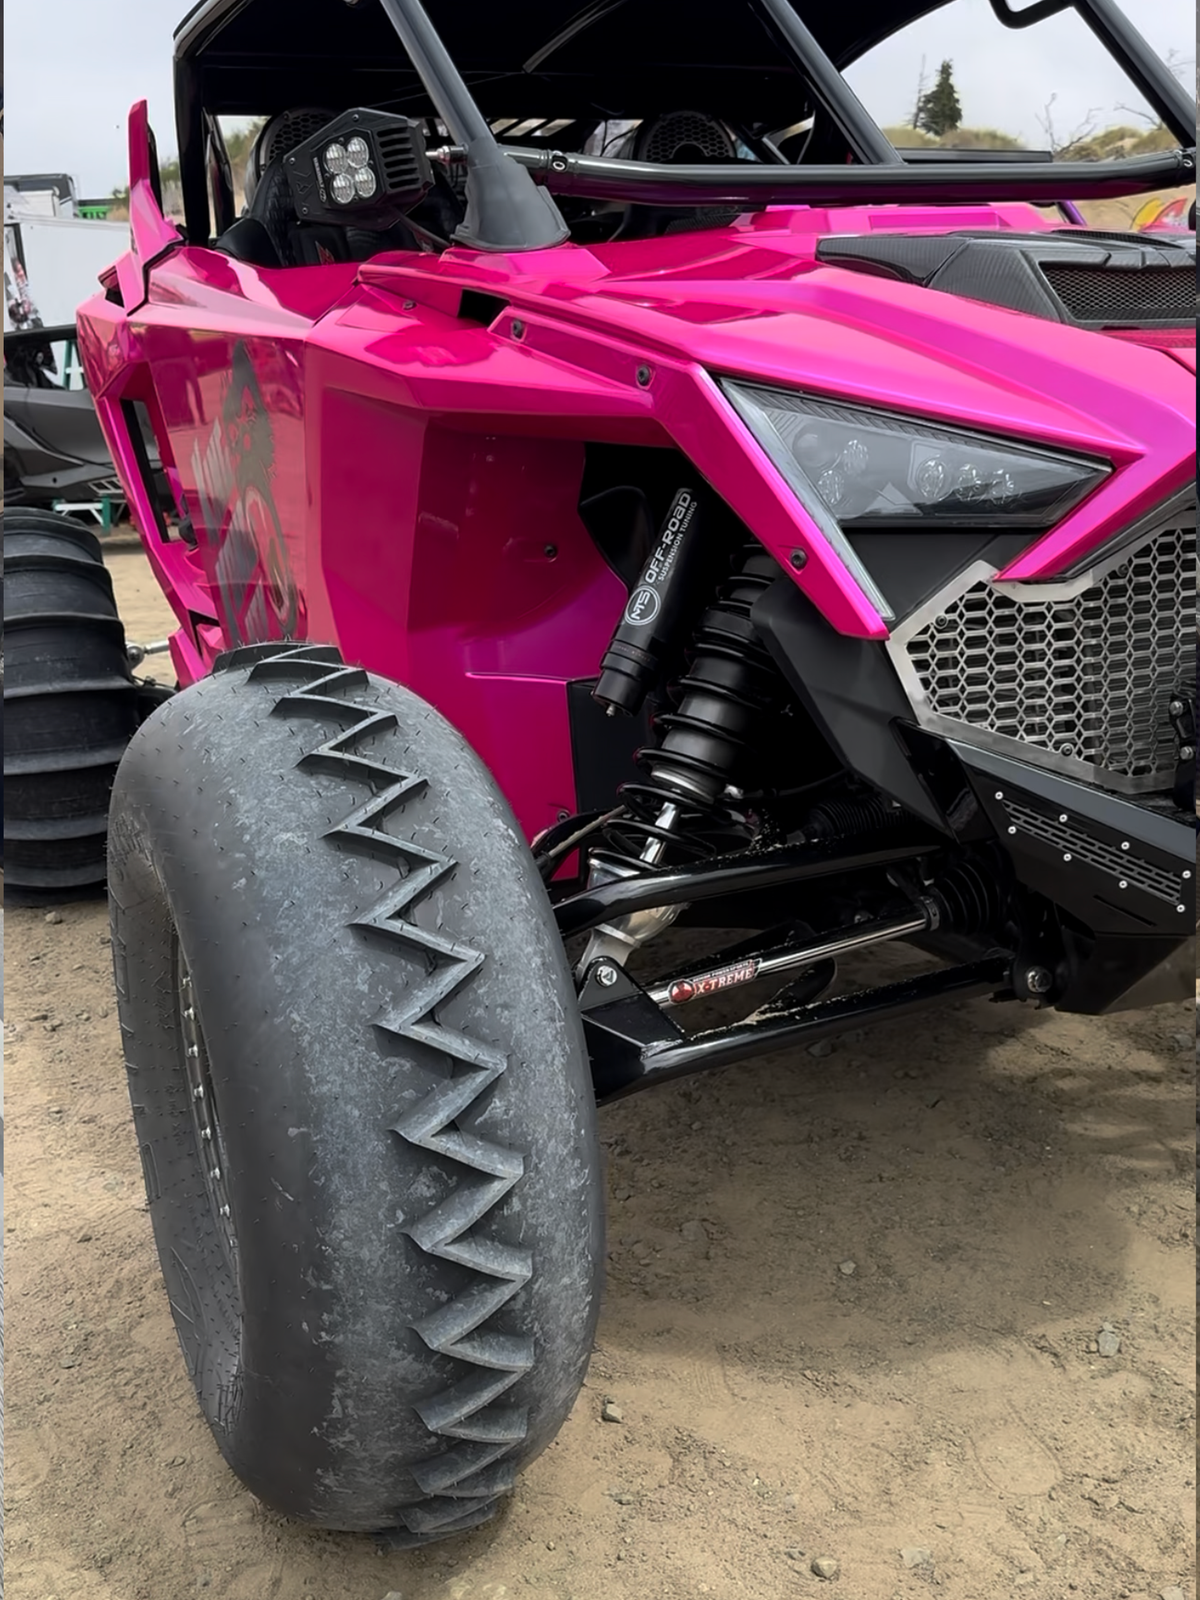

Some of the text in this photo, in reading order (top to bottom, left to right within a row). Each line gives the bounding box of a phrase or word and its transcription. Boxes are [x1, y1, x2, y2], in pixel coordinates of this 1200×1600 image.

[658, 501, 698, 581] SUSPENSION TUNING
[630, 590, 651, 620] MTS
[697, 968, 753, 995] X-TREME
